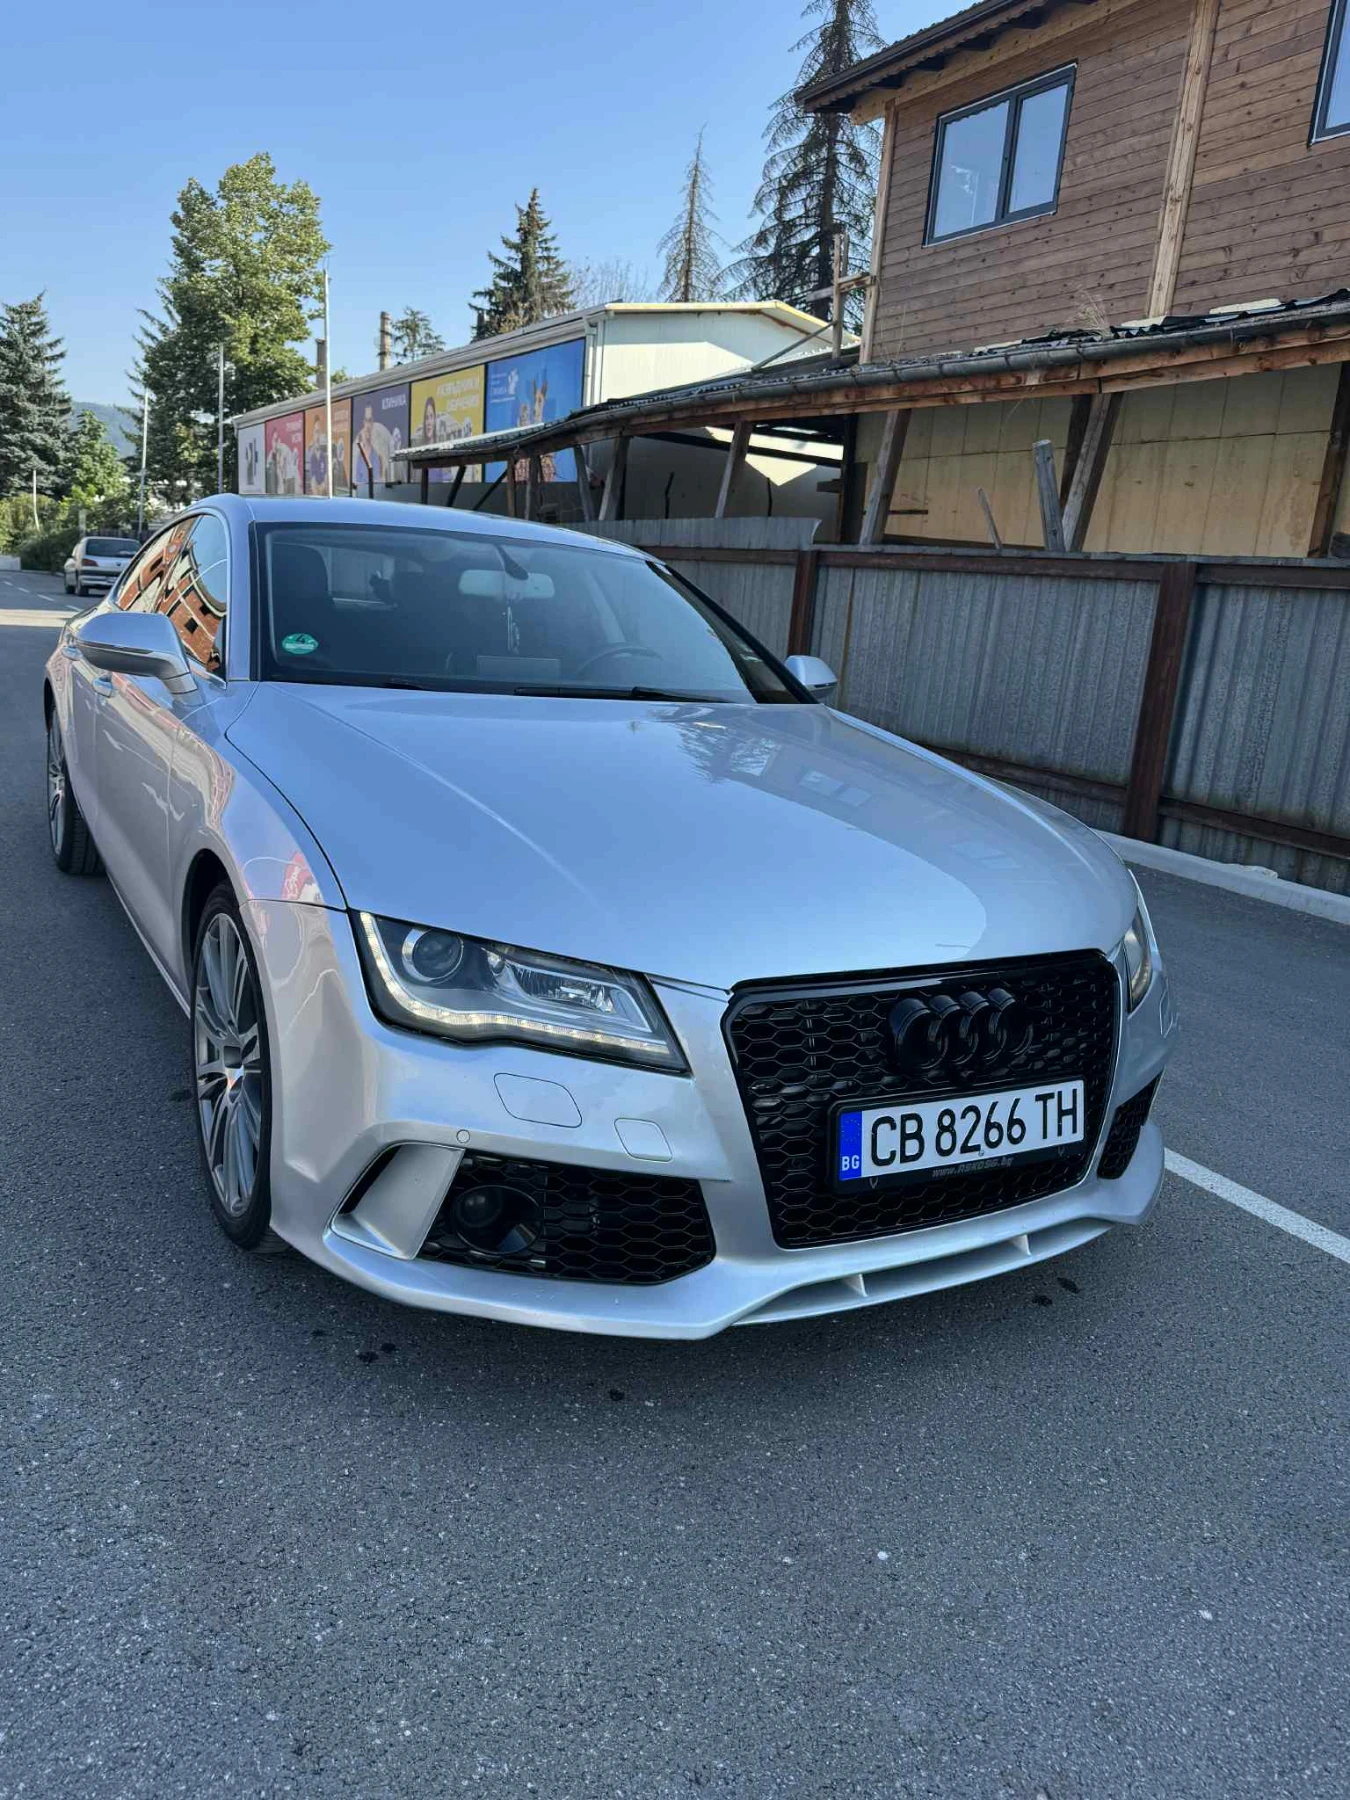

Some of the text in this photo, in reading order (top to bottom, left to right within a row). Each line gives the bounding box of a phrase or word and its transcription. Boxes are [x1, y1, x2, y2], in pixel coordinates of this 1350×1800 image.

[871, 1088, 1078, 1167] CB 8266 TH
[841, 1155, 860, 1172] BG
